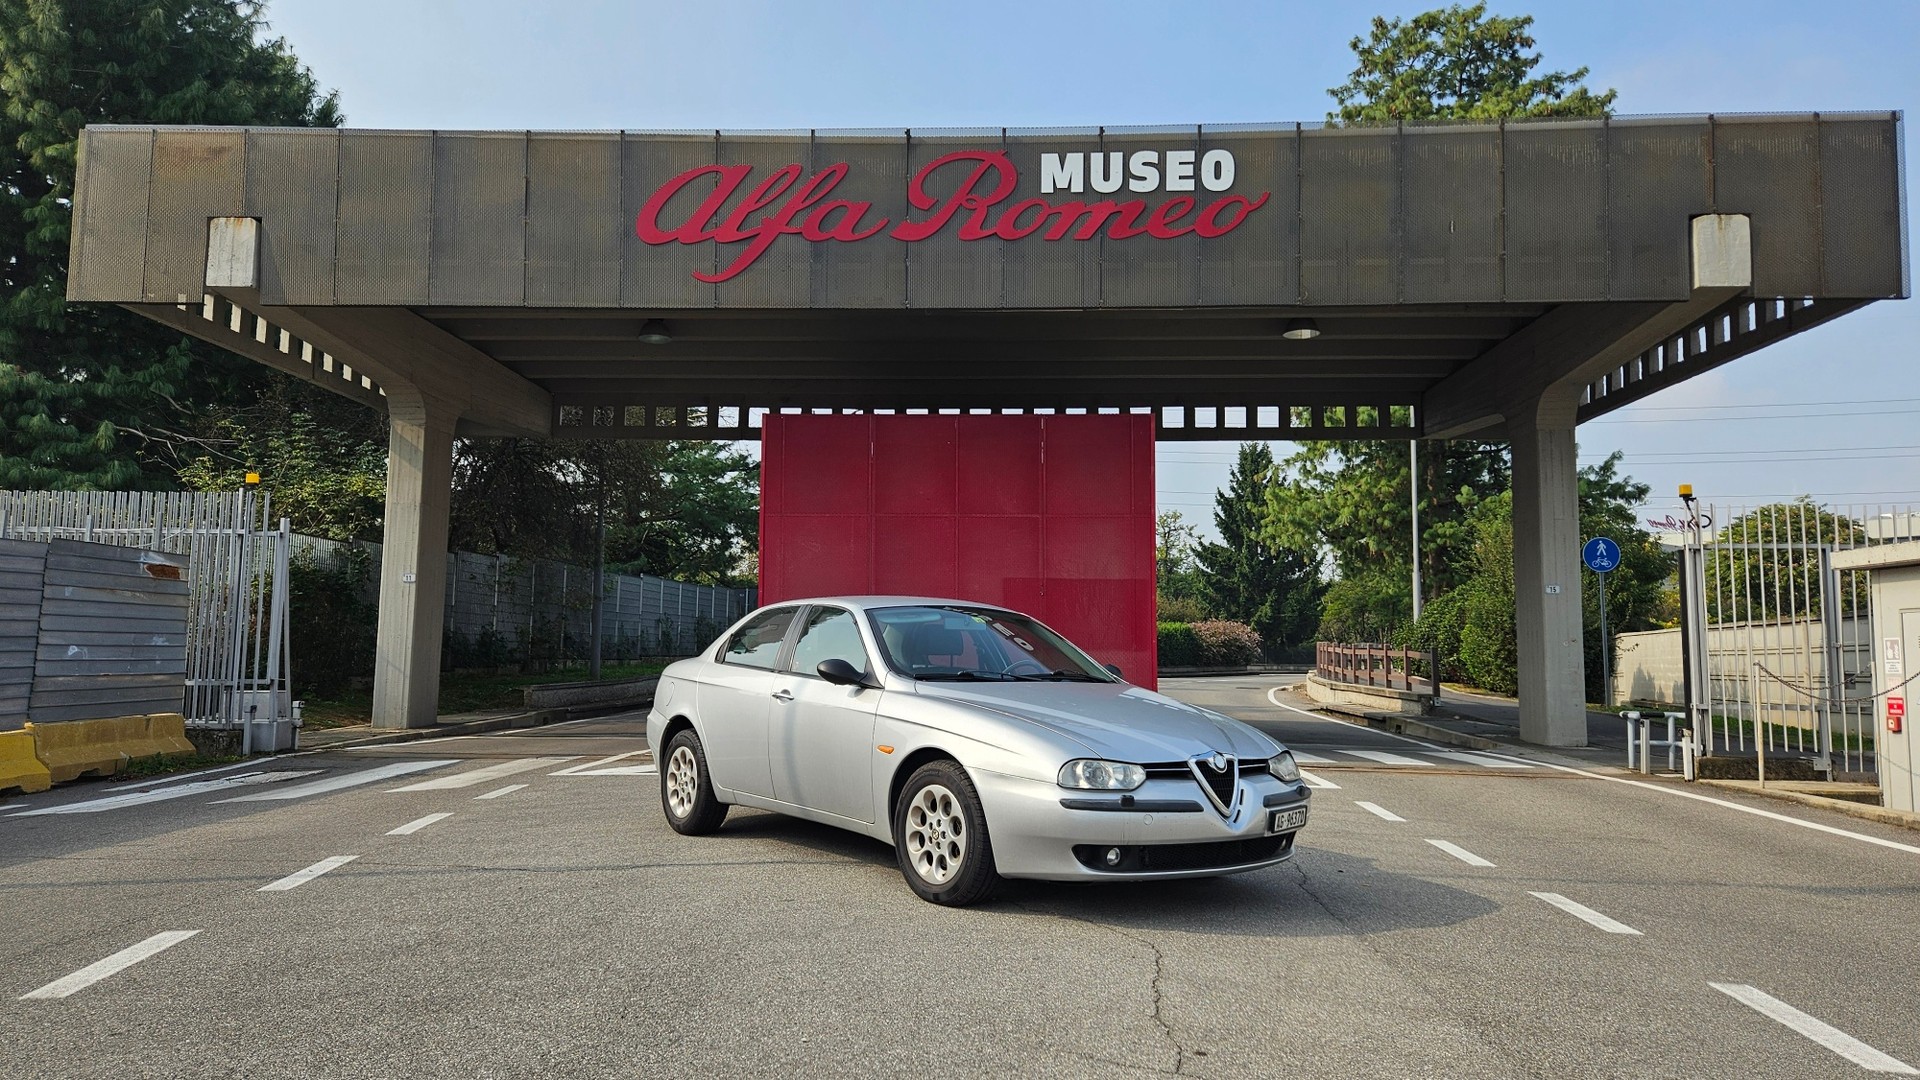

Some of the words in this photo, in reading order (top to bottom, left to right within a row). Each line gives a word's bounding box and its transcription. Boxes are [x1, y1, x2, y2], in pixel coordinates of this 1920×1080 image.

[1041, 150, 1235, 194] MUSEO
[636, 162, 888, 283] Alfa
[891, 151, 1270, 242] Romeo
